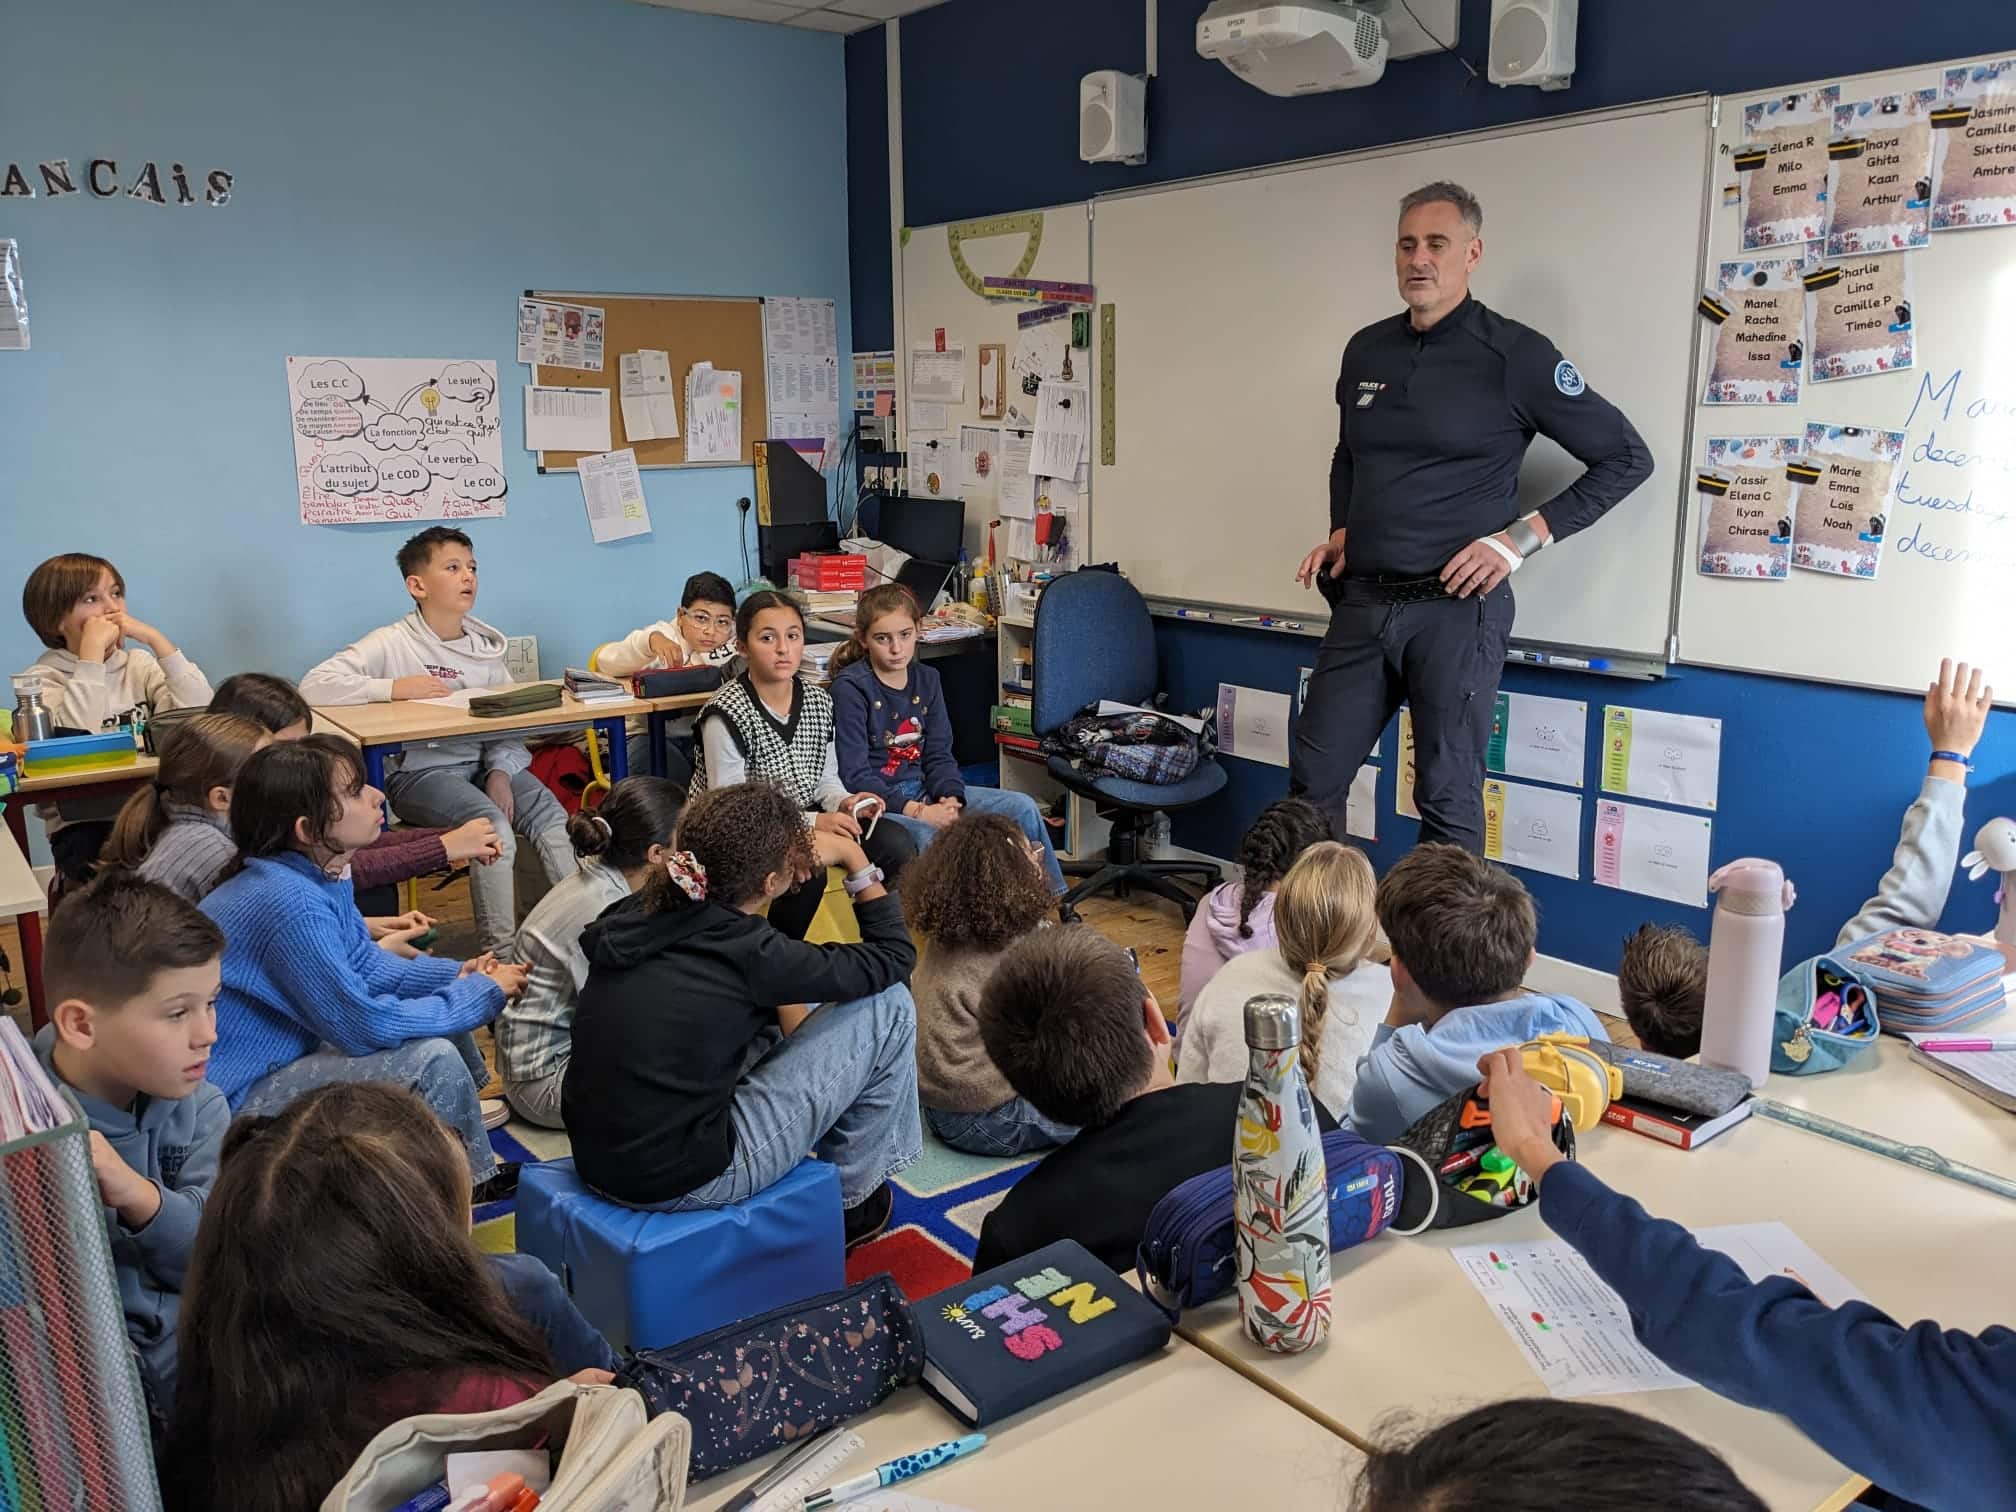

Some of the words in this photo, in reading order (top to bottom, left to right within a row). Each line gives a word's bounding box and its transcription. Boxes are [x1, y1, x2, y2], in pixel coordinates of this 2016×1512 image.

[1806, 136, 1815, 147] R
[1866, 154, 1900, 168] Ghita
[1777, 161, 1802, 174] Milo
[1972, 165, 2016, 178] Ambre
[1868, 174, 1899, 187] Kaan
[1773, 183, 1808, 196] Emma
[1862, 193, 1903, 207] Arthur
[1838, 263, 1880, 279] Charlie
[1847, 282, 1874, 294] Lina
[1744, 299, 1778, 309] Manel
[1833, 299, 1880, 315] Camille
[1883, 295, 1892, 307] P
[1744, 314, 1779, 325] Racha
[1844, 318, 1882, 333] Timéo
[1748, 351, 1771, 361] Issa
[310, 379, 329, 389] Les
[448, 377, 458, 385] Le
[460, 376, 481, 388] sujet
[370, 429, 380, 438] La
[382, 427, 417, 437] fonction
[427, 455, 440, 463] Le
[442, 454, 472, 464] verbe
[320, 463, 372, 474] L'attribut
[1829, 464, 1862, 478] Marie
[381, 472, 394, 481] Le
[396, 469, 420, 480] COD
[325, 478, 339, 488] du
[342, 479, 369, 490] sujet
[464, 478, 477, 488] Le
[478, 478, 496, 488] COI
[1828, 480, 1860, 494] Emna
[1729, 490, 1761, 501] Elena
[1763, 490, 1772, 501] C
[1736, 506, 1764, 522] Ilyan
[1823, 517, 1852, 531] Noah
[1728, 525, 1770, 537] Chirase
